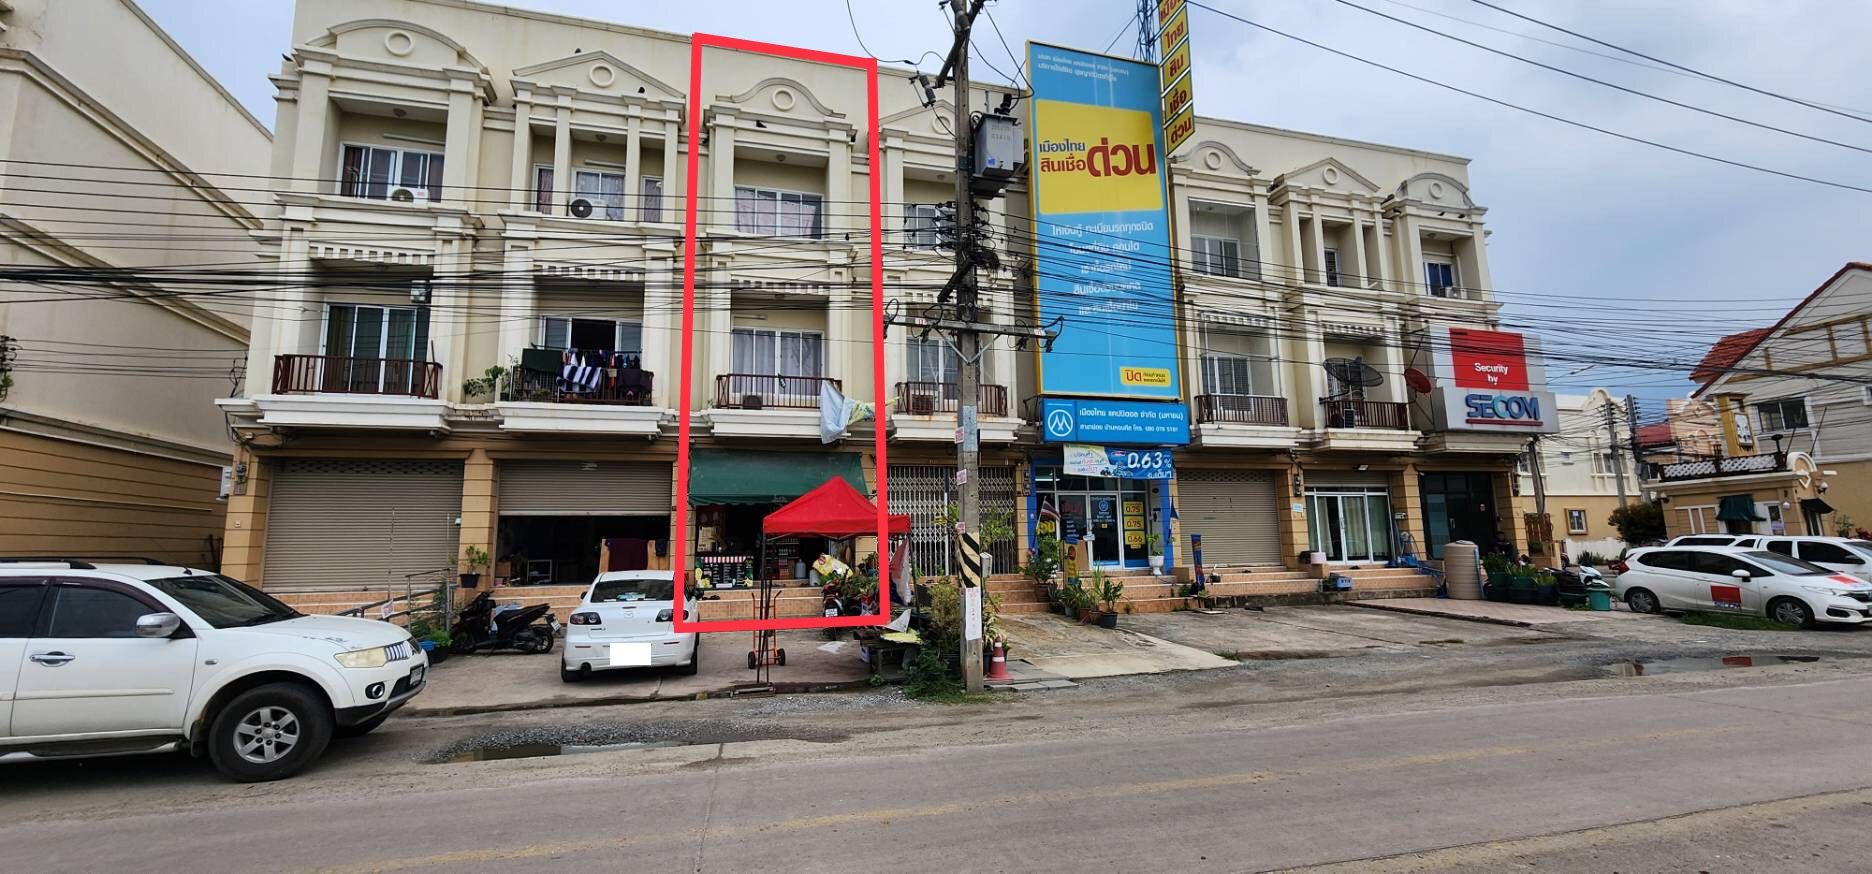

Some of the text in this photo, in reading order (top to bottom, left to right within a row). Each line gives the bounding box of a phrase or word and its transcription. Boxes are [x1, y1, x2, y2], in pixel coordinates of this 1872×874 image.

[1165, 22, 1184, 48] ไทย
[1170, 54, 1184, 76] สิน
[1170, 89, 1187, 114] เชื่อ
[1171, 117, 1192, 144] ด่วน
[1039, 138, 1086, 153] เมืองไทย
[1040, 137, 1157, 178] สินเชื่อ ด่วน
[1474, 362, 1508, 375] Security
[1487, 374, 1498, 385] by
[1079, 407, 1107, 417] เมืองไทย
[1158, 411, 1184, 421] (มหาชน)
[1465, 394, 1540, 420] SECOM
[1127, 452, 1163, 469] 0.63
[1125, 505, 1141, 513] 0.75
[1126, 520, 1142, 528] 0.75
